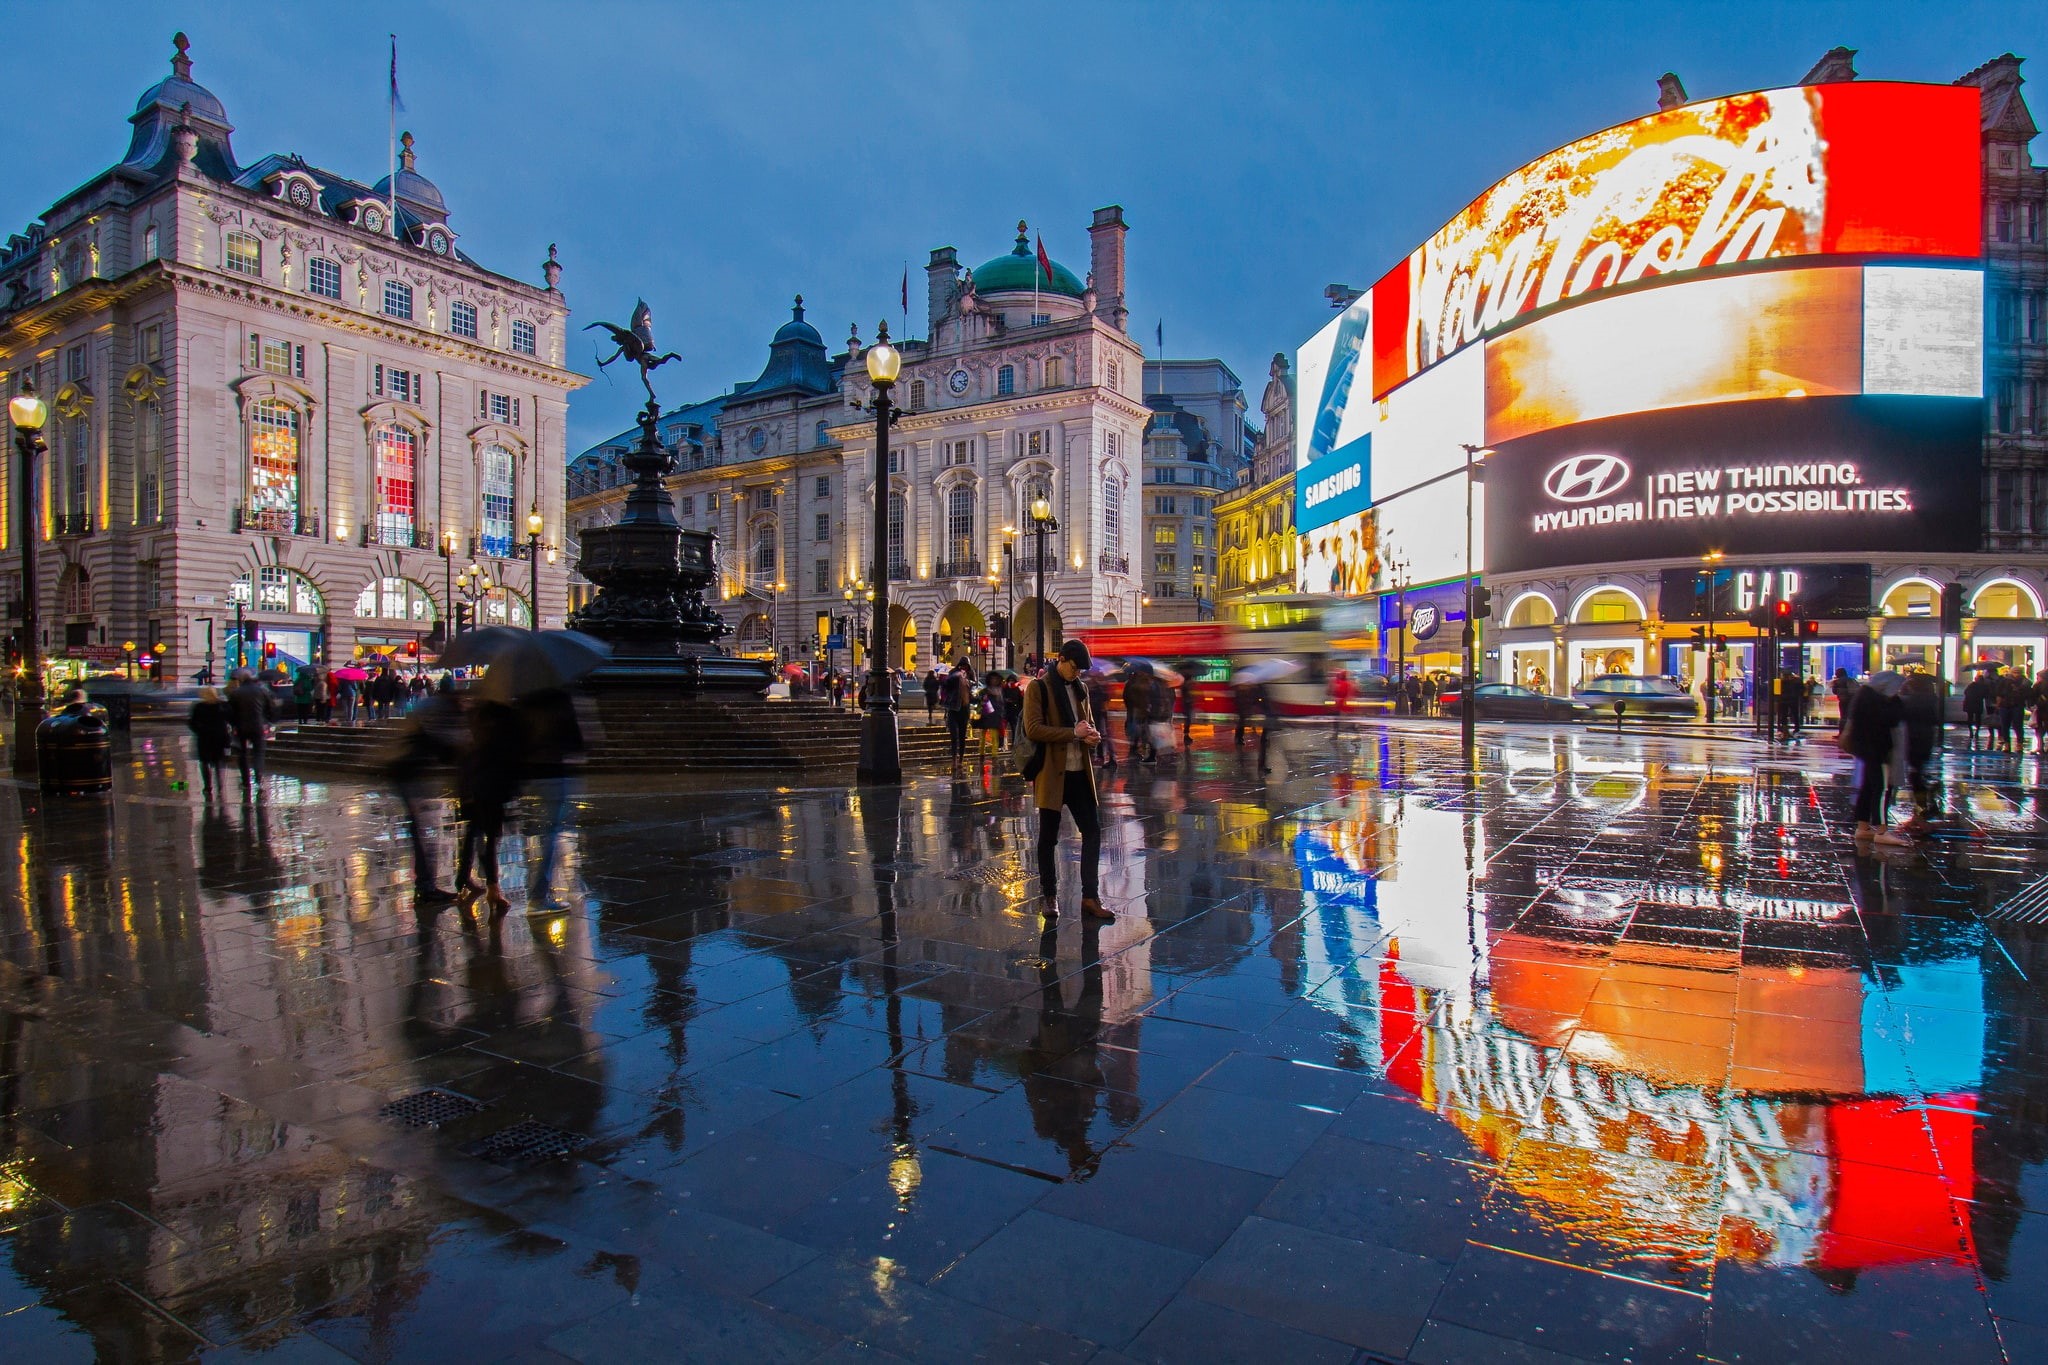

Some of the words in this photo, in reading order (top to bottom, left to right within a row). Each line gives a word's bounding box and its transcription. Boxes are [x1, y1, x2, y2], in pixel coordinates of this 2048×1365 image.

[1305, 463, 1361, 509] SAMSUNG
[1658, 469, 1721, 494] NEW
[1726, 463, 1861, 489] THINKING.
[1534, 501, 1643, 533] HYUNDAI
[1658, 495, 1721, 519] NEW
[1726, 489, 1912, 515] POSSIBILITIES.
[1738, 571, 1799, 611] GAP
